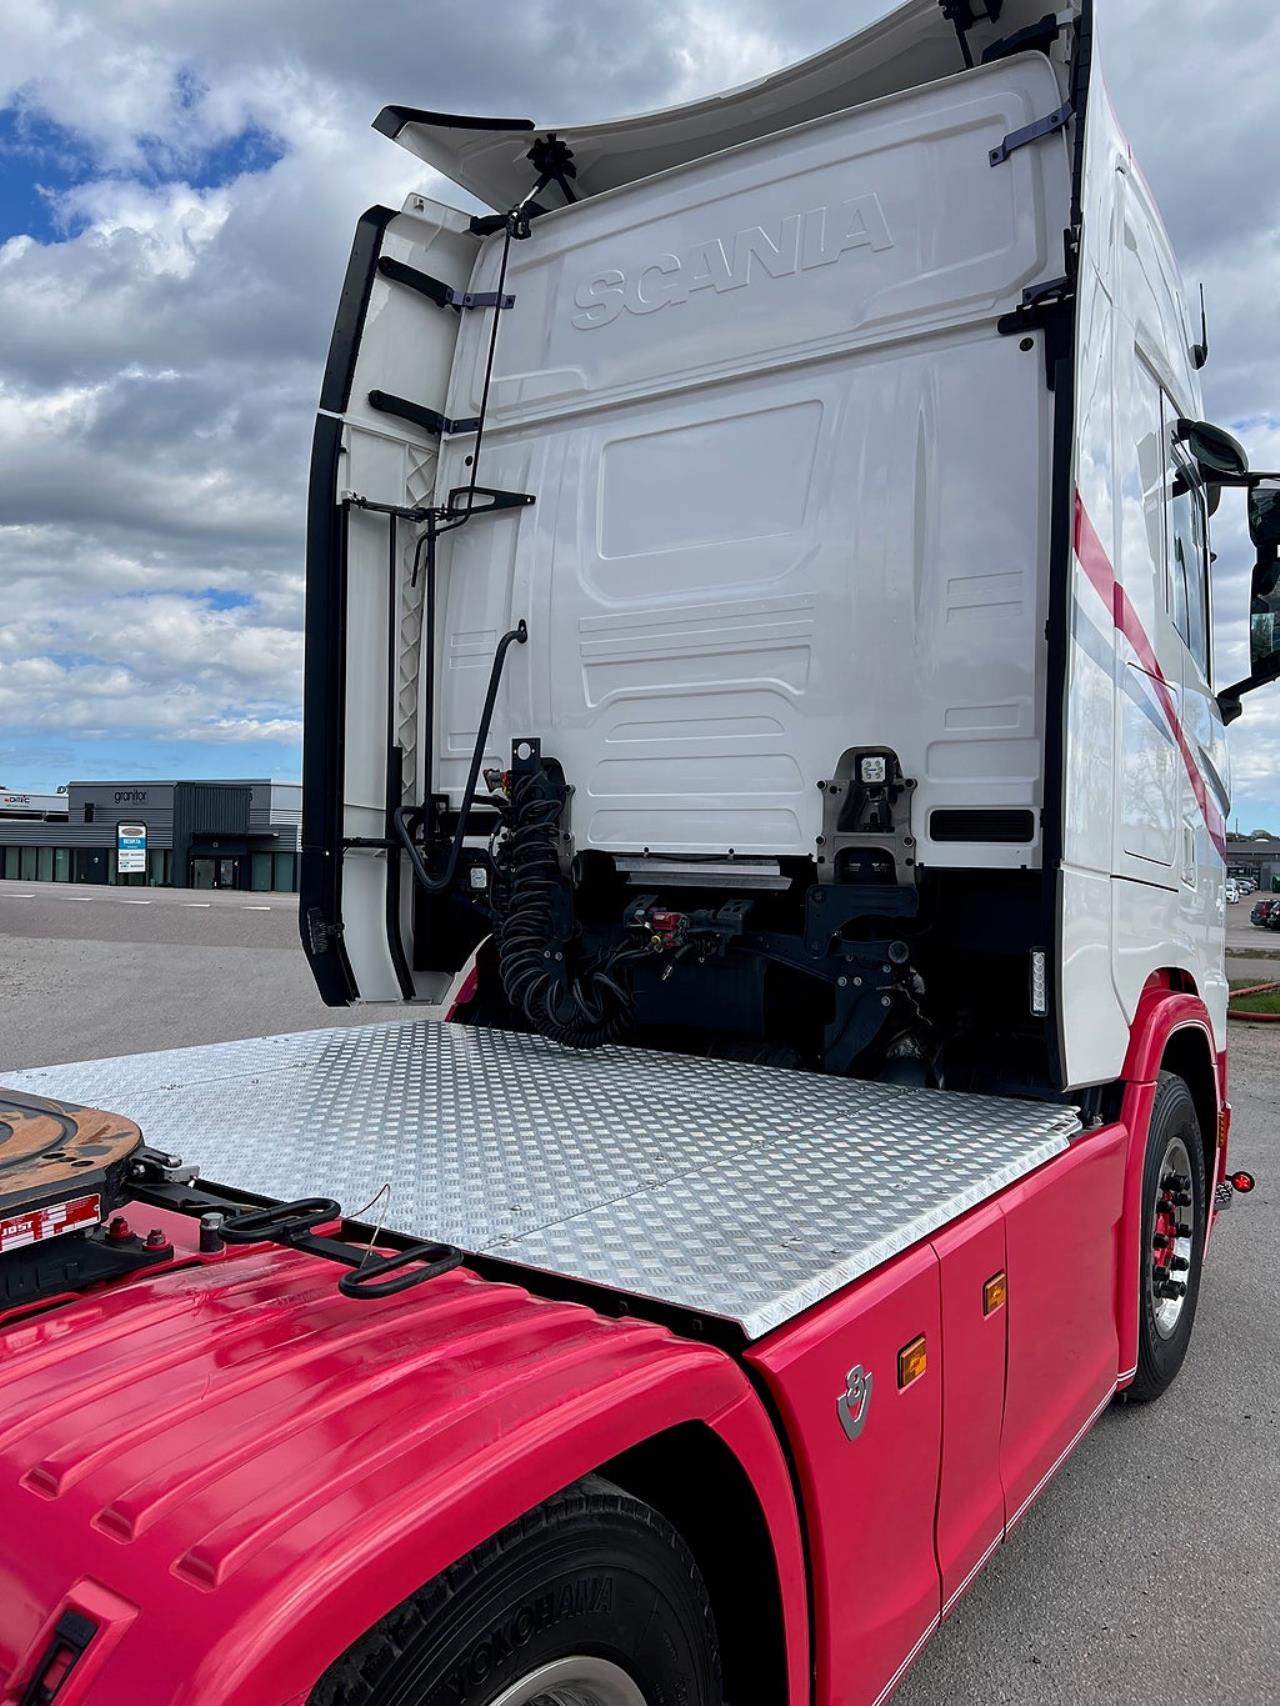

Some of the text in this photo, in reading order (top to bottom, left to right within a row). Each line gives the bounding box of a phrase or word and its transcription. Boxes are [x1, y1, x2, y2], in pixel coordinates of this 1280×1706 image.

[571, 192, 894, 330] SCANIA
[1, 1220, 32, 1236] JOST
[443, 1577, 614, 1704] YOKOHAMA
